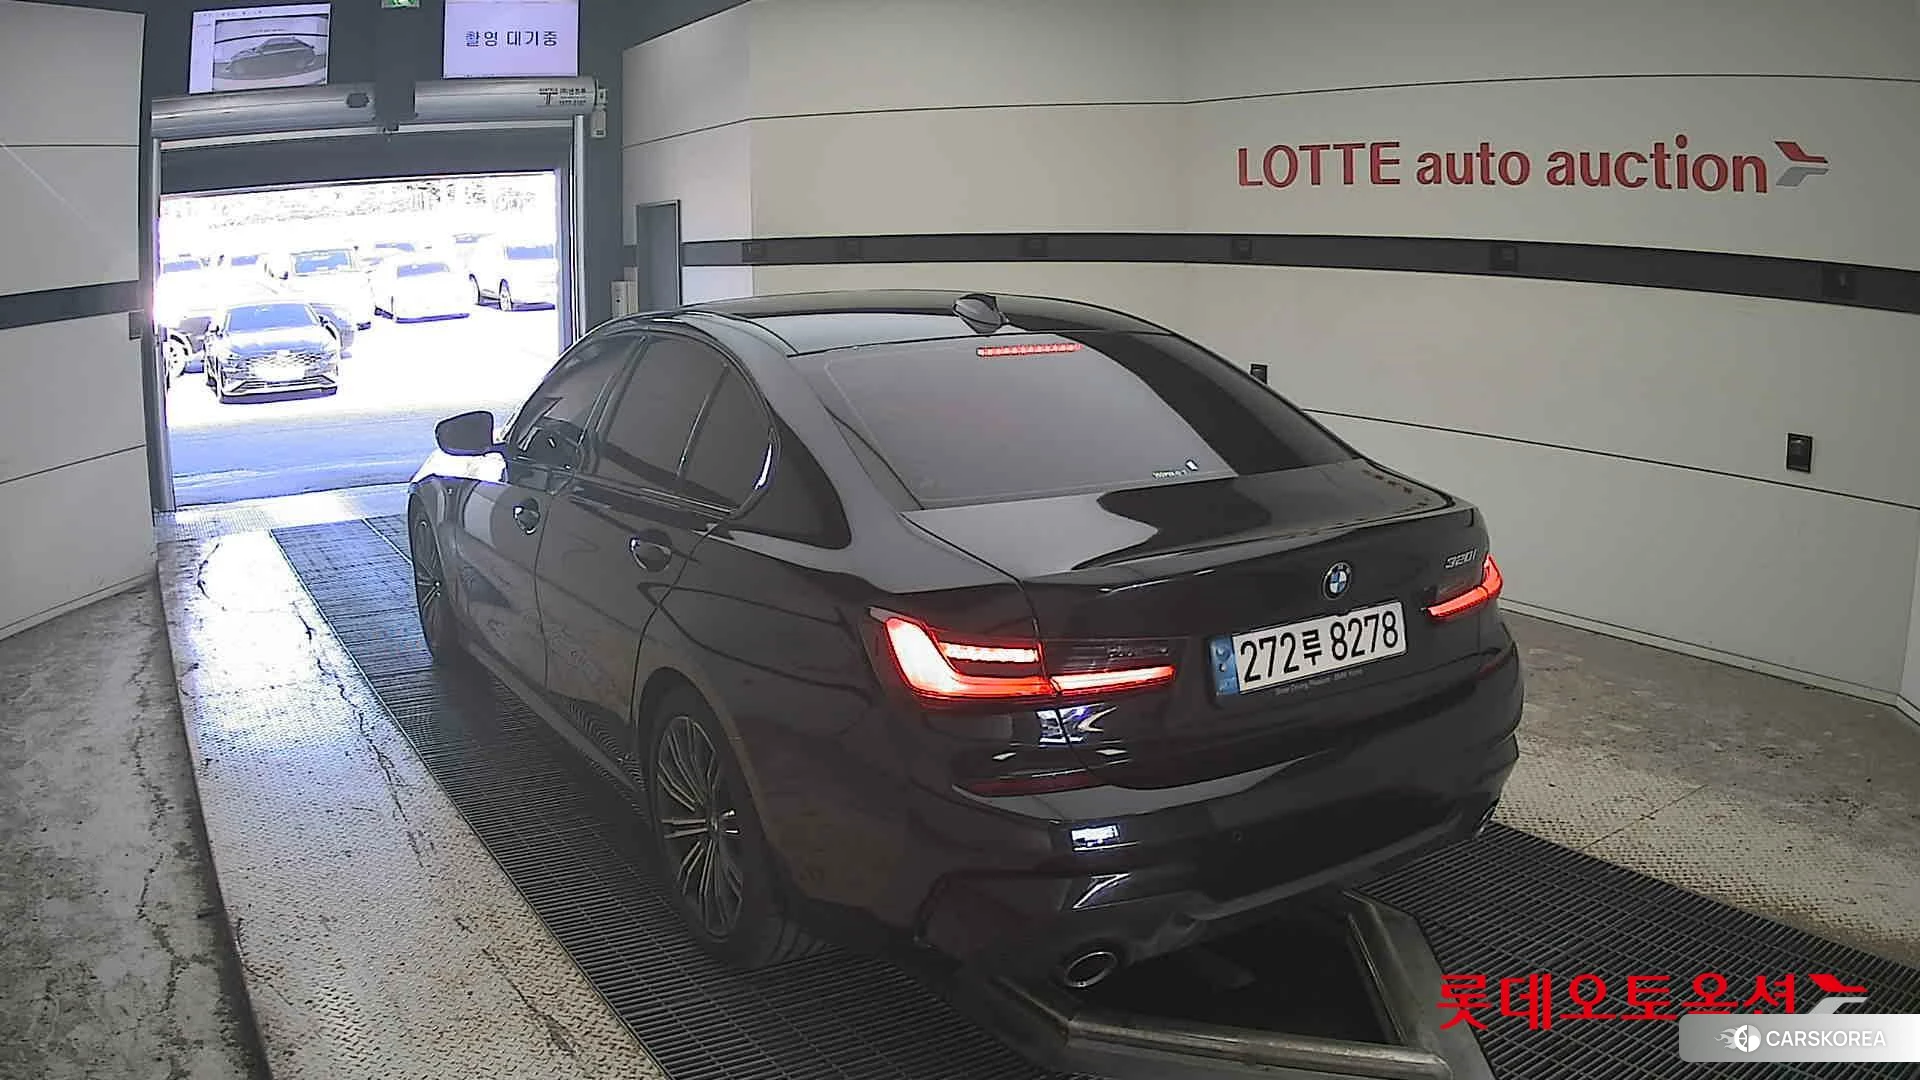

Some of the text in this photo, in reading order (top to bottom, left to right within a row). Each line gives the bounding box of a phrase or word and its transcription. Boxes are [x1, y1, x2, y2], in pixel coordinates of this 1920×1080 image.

[506, 30, 558, 47] 대기중
[1238, 134, 1768, 194] LOTTE auto auction
[1444, 548, 1477, 569] 320i
[1239, 629, 1323, 684] 272루
[1329, 610, 1399, 662] 8278
